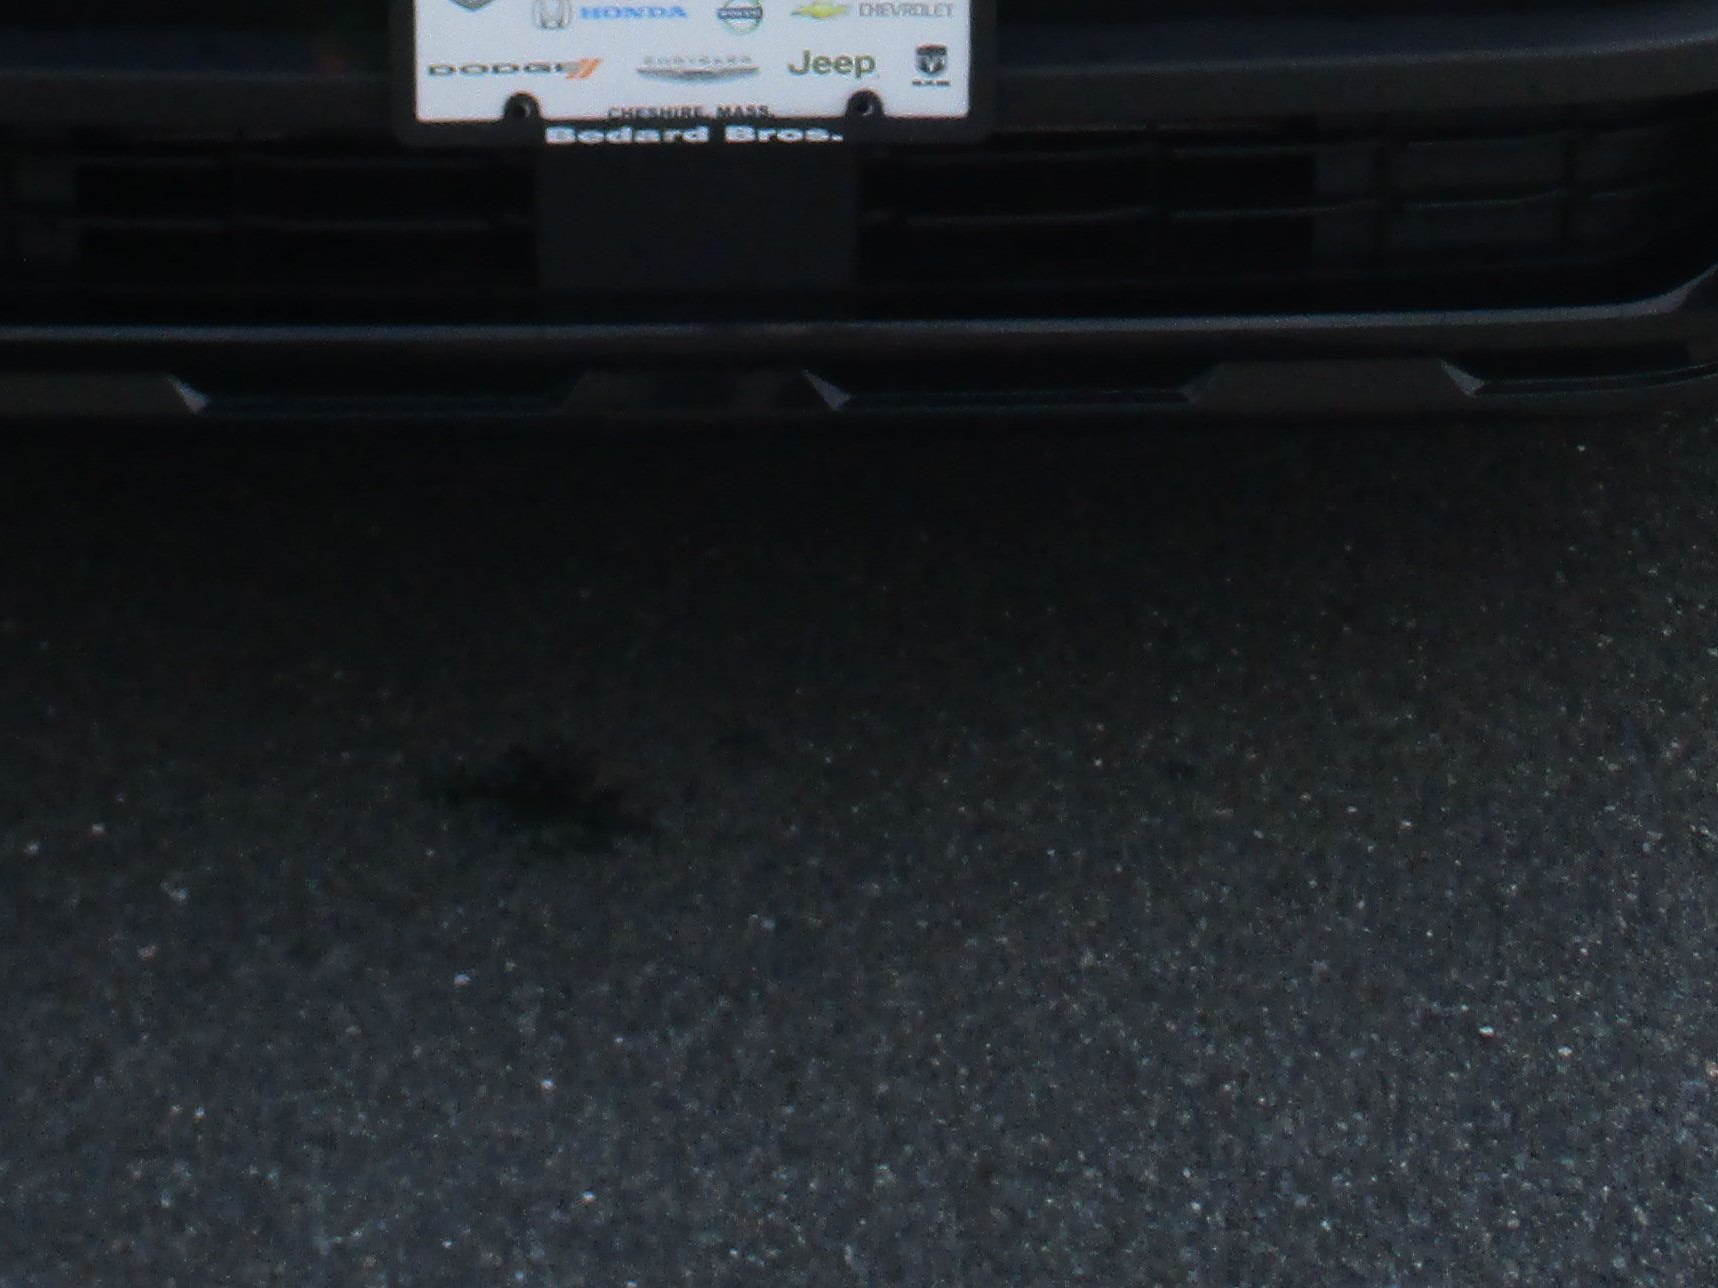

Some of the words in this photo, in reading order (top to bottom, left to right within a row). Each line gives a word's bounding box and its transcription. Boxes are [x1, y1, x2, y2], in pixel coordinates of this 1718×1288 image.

[579, 6, 688, 19] HONDA
[859, 1, 955, 18] CHEVROLET
[788, 49, 877, 79] Jeep
[545, 126, 710, 145] Bedard
[724, 125, 844, 143] Bros.
